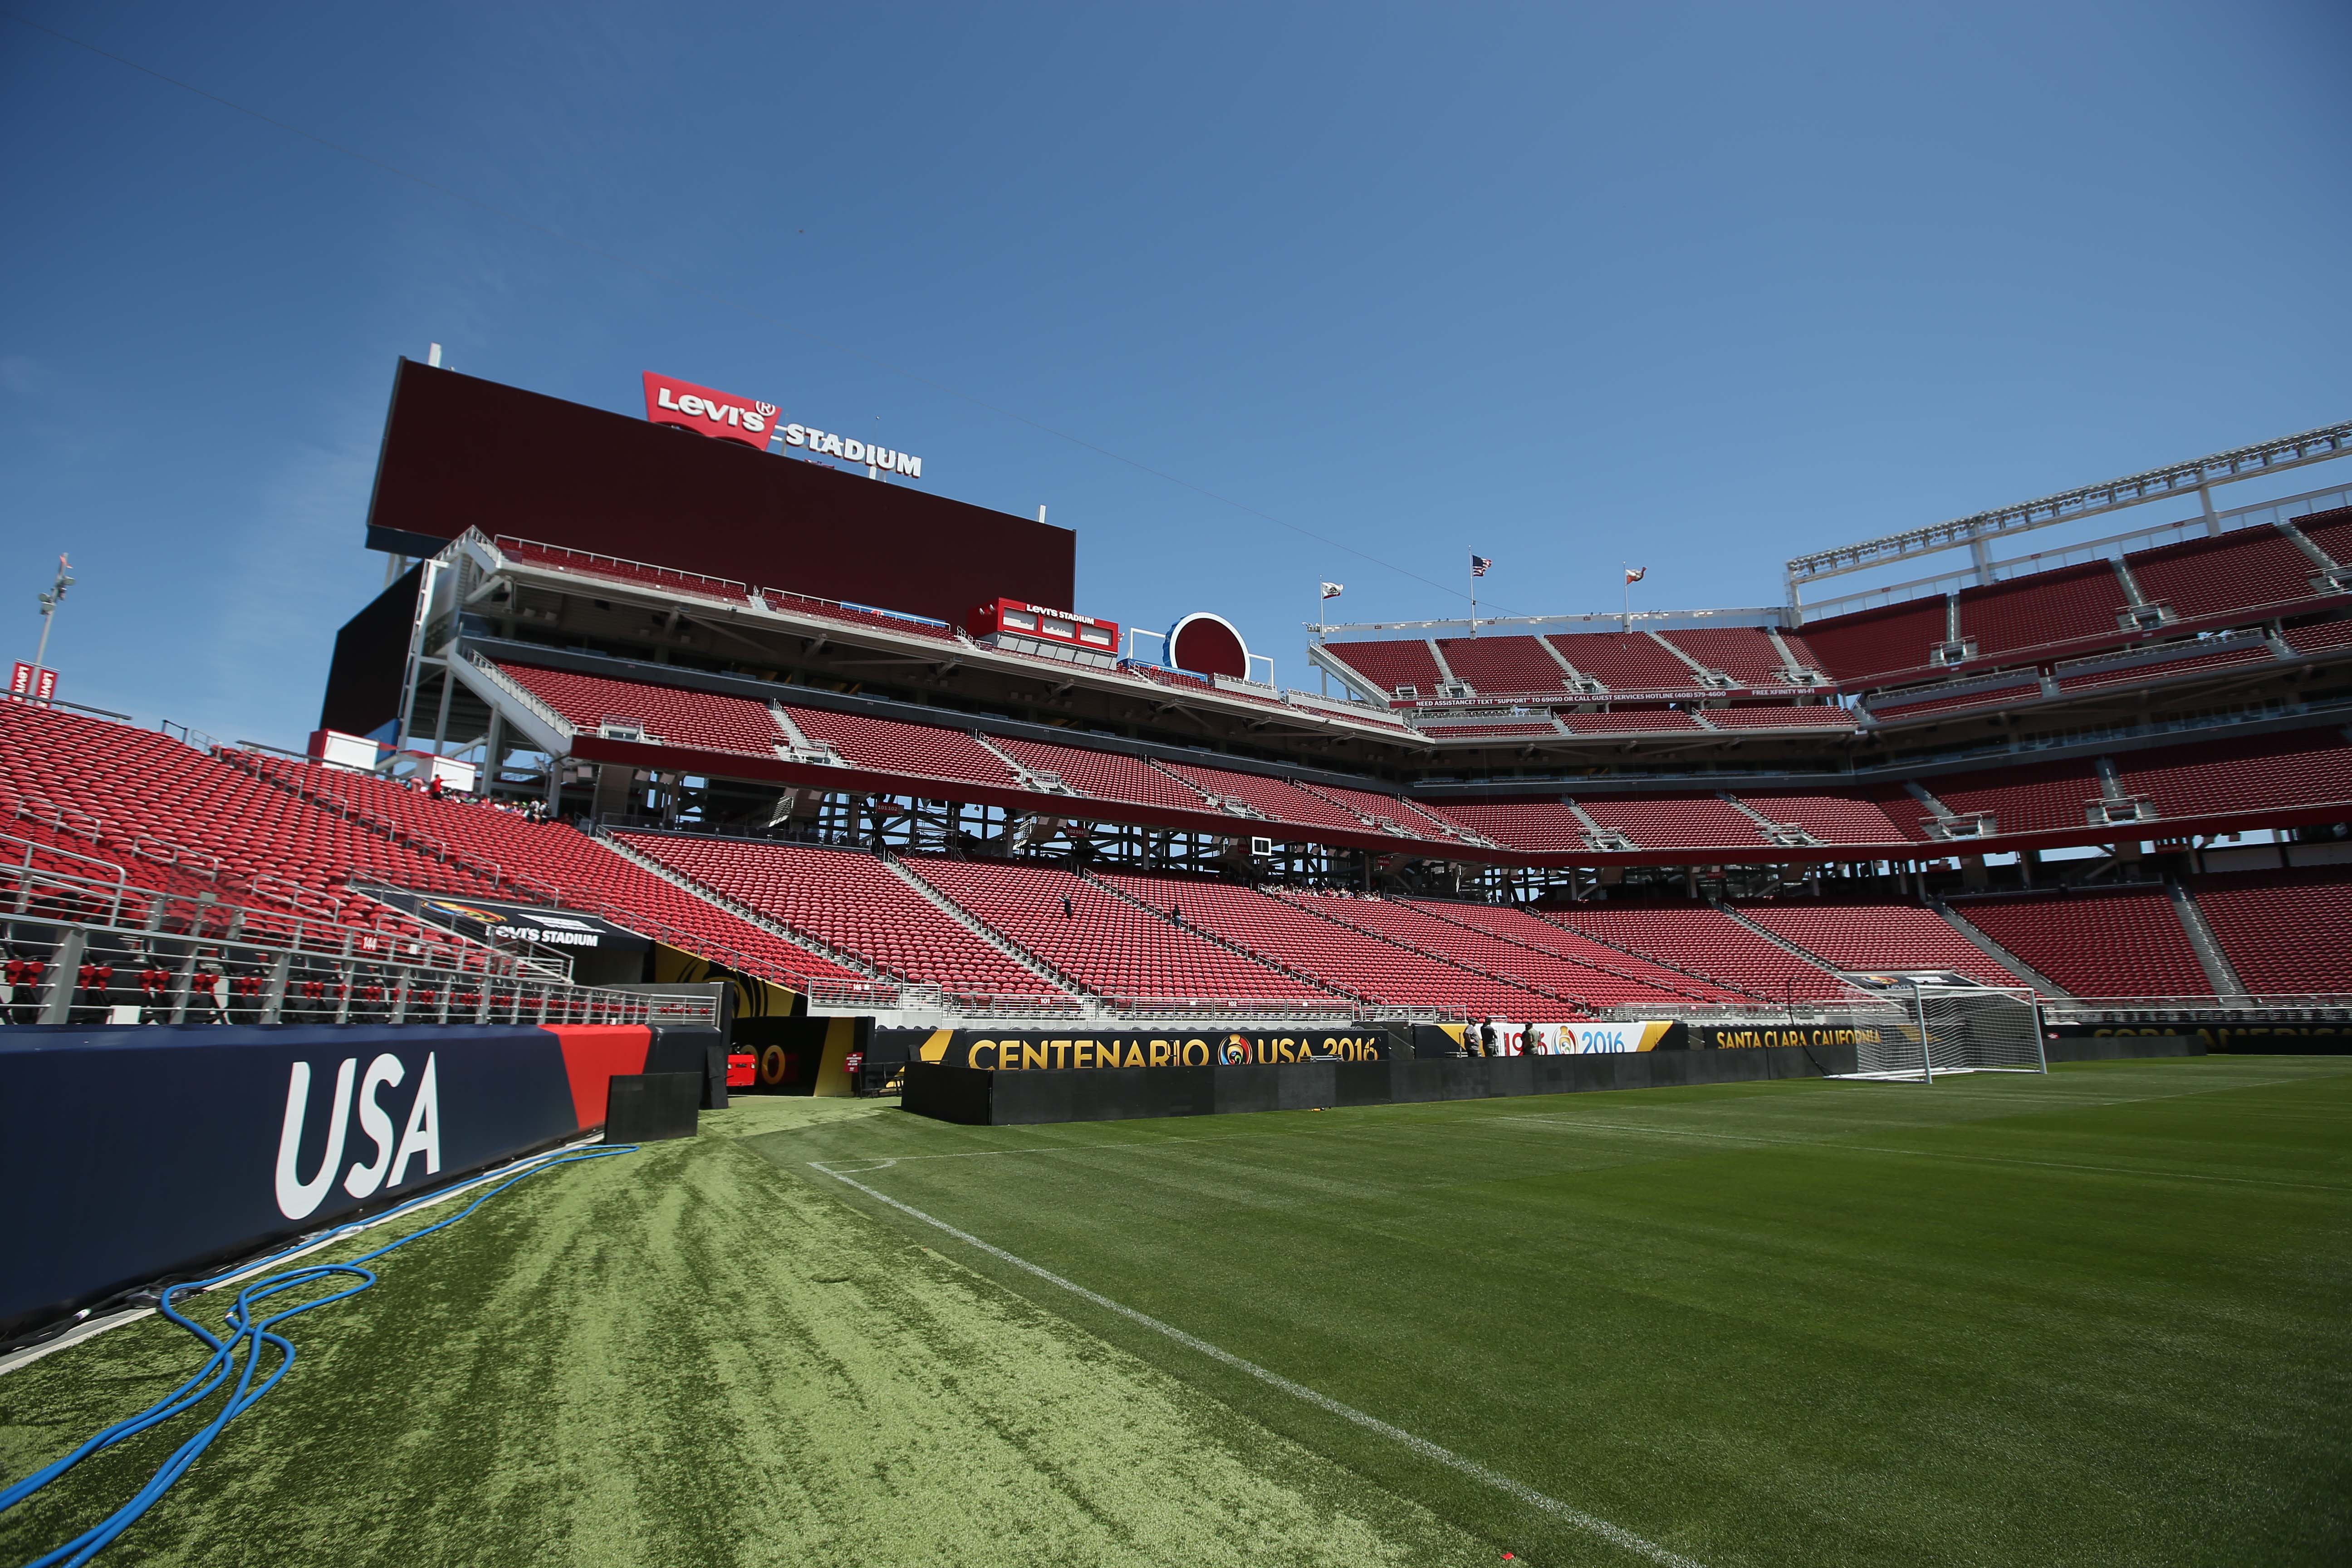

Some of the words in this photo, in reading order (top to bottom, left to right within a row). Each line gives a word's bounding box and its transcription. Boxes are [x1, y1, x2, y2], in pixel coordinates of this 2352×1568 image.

[786, 423, 921, 478] STADIUM
[1059, 611, 1094, 625] STADIUM
[363, 936, 378, 951] 144
[541, 930, 598, 947] STADIUM
[1505, 1032, 1548, 1057] 196
[1582, 1031, 1625, 1054] 2016
[1716, 1031, 1762, 1049] SANTA
[1813, 1029, 1882, 1046] CALIFORNIA
[968, 1039, 1209, 1070] CENTENARIO
[1258, 1038, 1313, 1063] USA
[1323, 1037, 1378, 1061] 2016
[275, 1052, 441, 1220] USA
